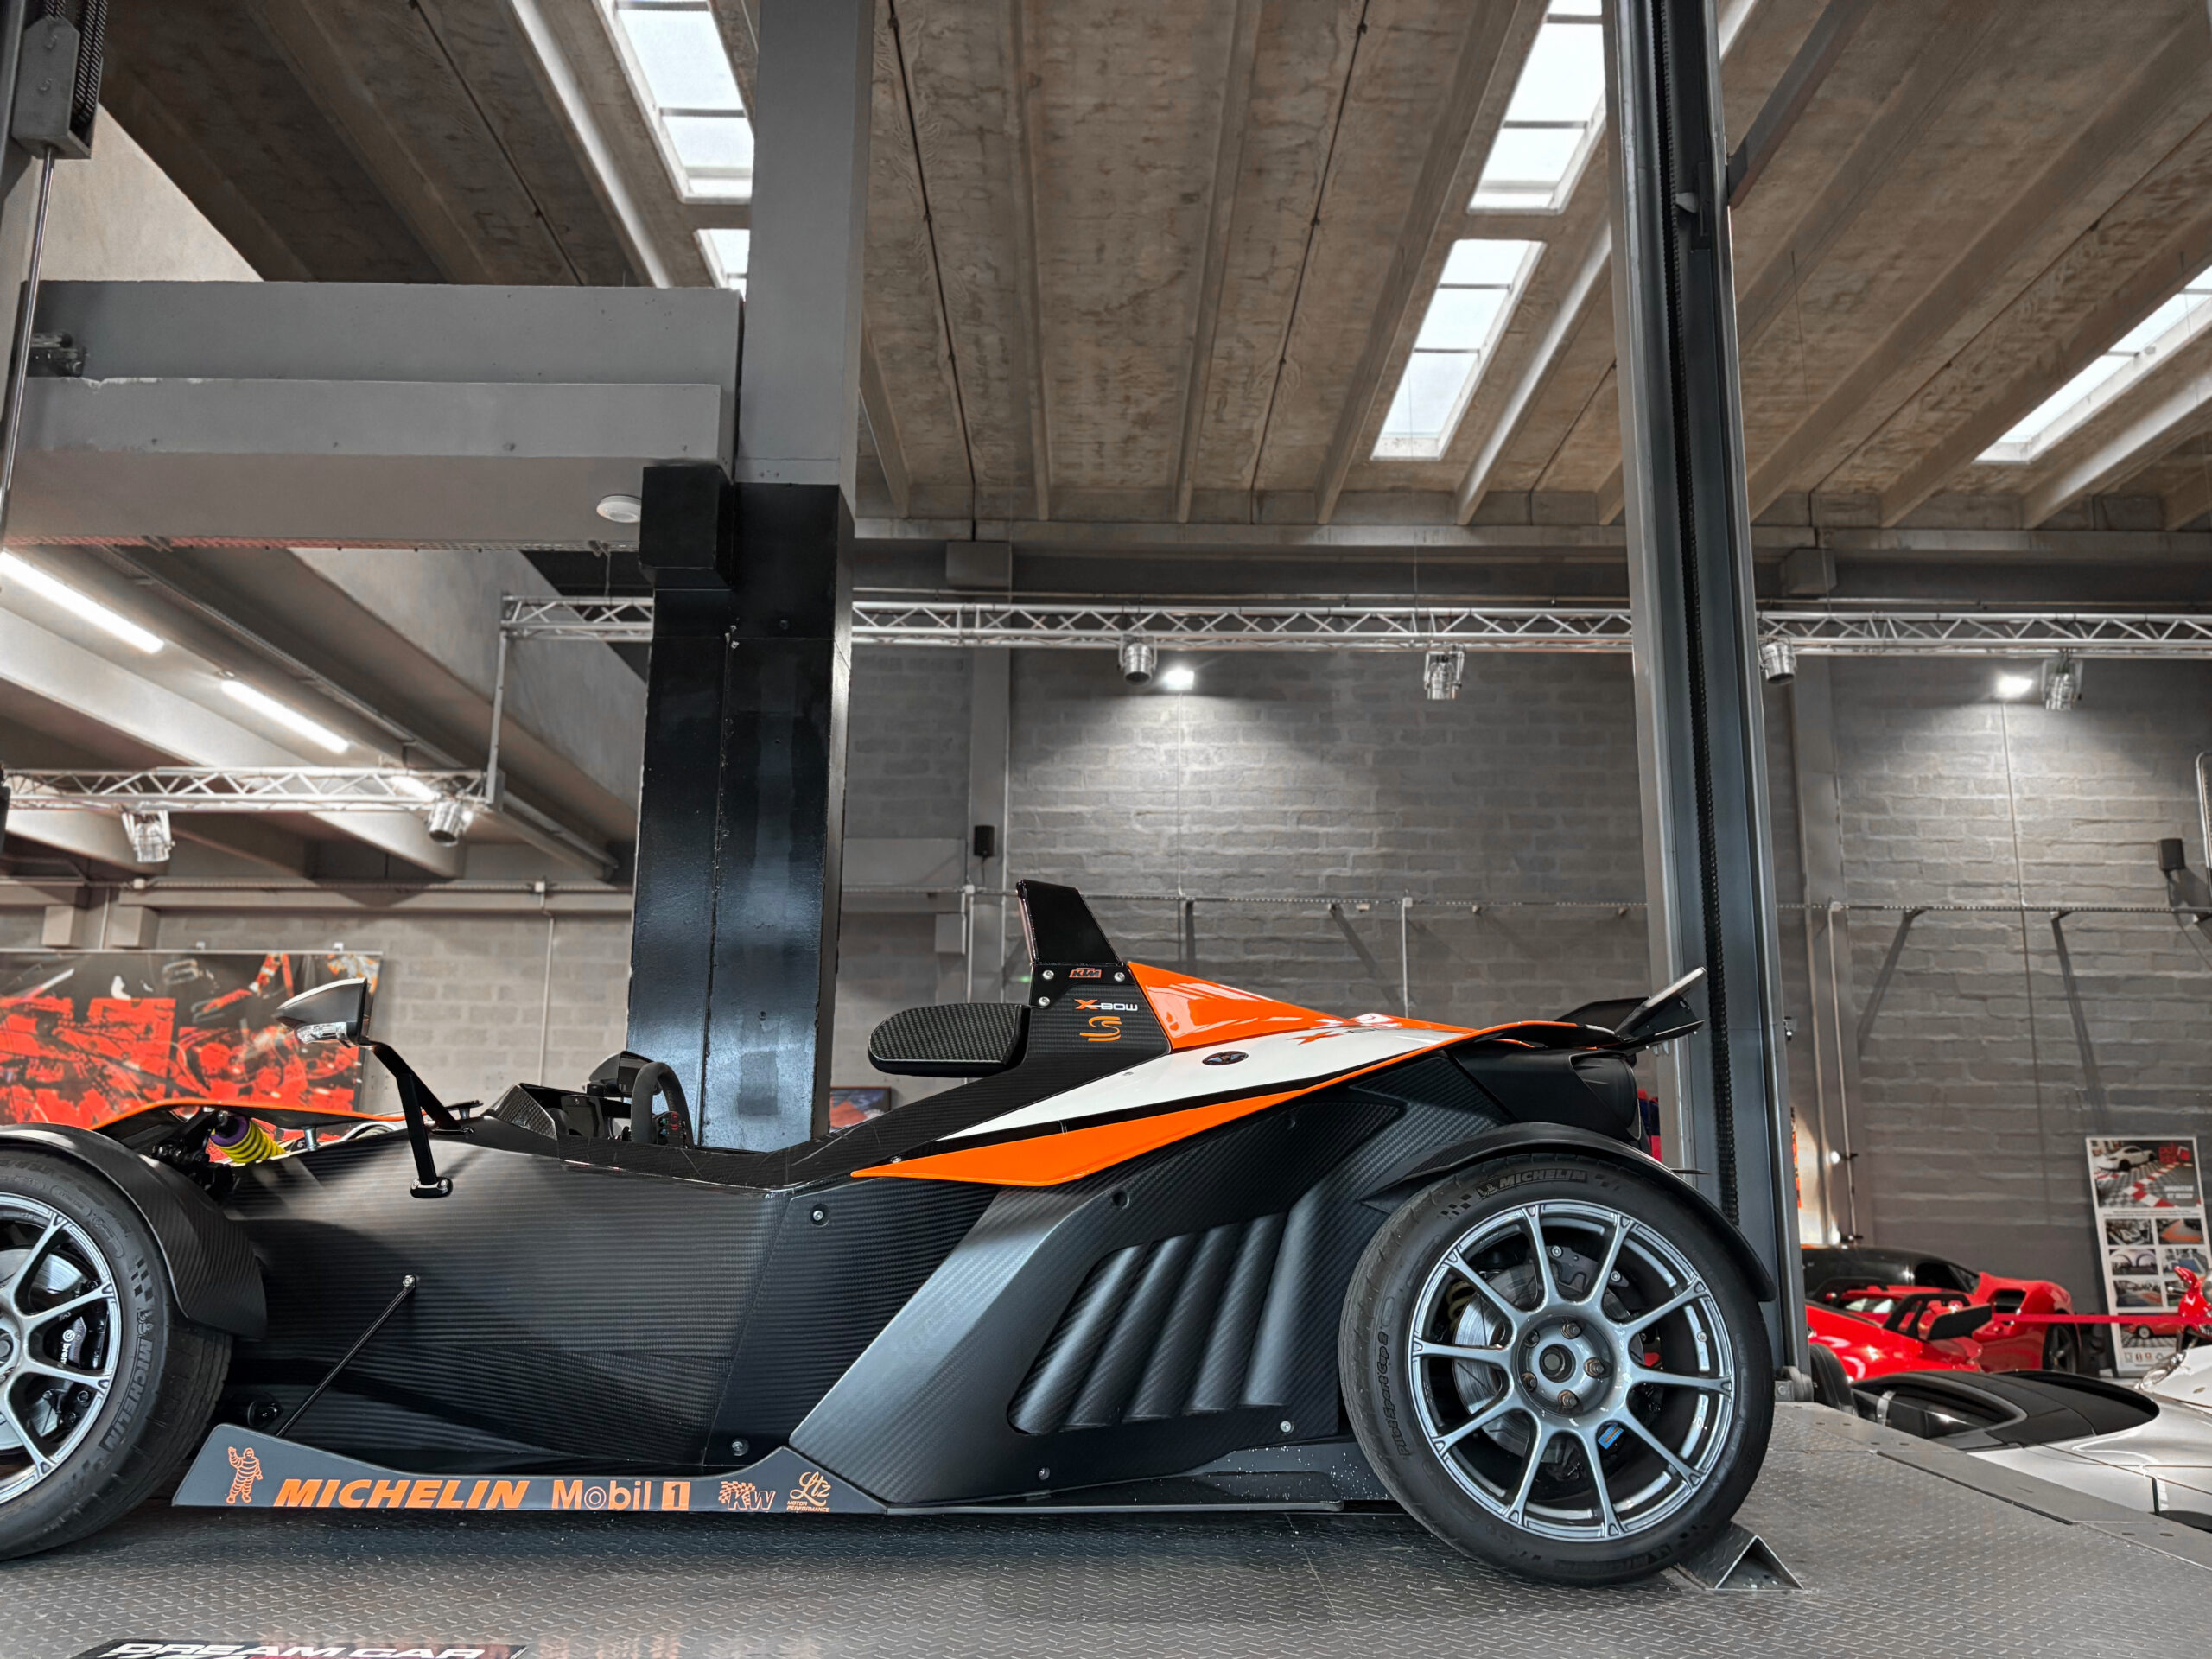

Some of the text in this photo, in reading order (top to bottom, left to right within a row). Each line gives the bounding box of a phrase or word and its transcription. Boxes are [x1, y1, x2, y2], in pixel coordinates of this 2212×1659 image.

[1070, 968, 1103, 978] KTM
[1079, 1016, 1122, 1042] S
[1499, 1169, 1587, 1189] MICHELIN
[1377, 1331, 1389, 1345] 2
[1377, 1346, 1389, 1375] Cup
[101, 1338, 153, 1452] MICHELIN
[1378, 1375, 1396, 1420] Sport
[273, 1478, 530, 1510] MICHELIN
[551, 1480, 651, 1510] Mobil
[727, 1489, 776, 1511] KW
[105, 1643, 486, 1659] DREAM CAR
